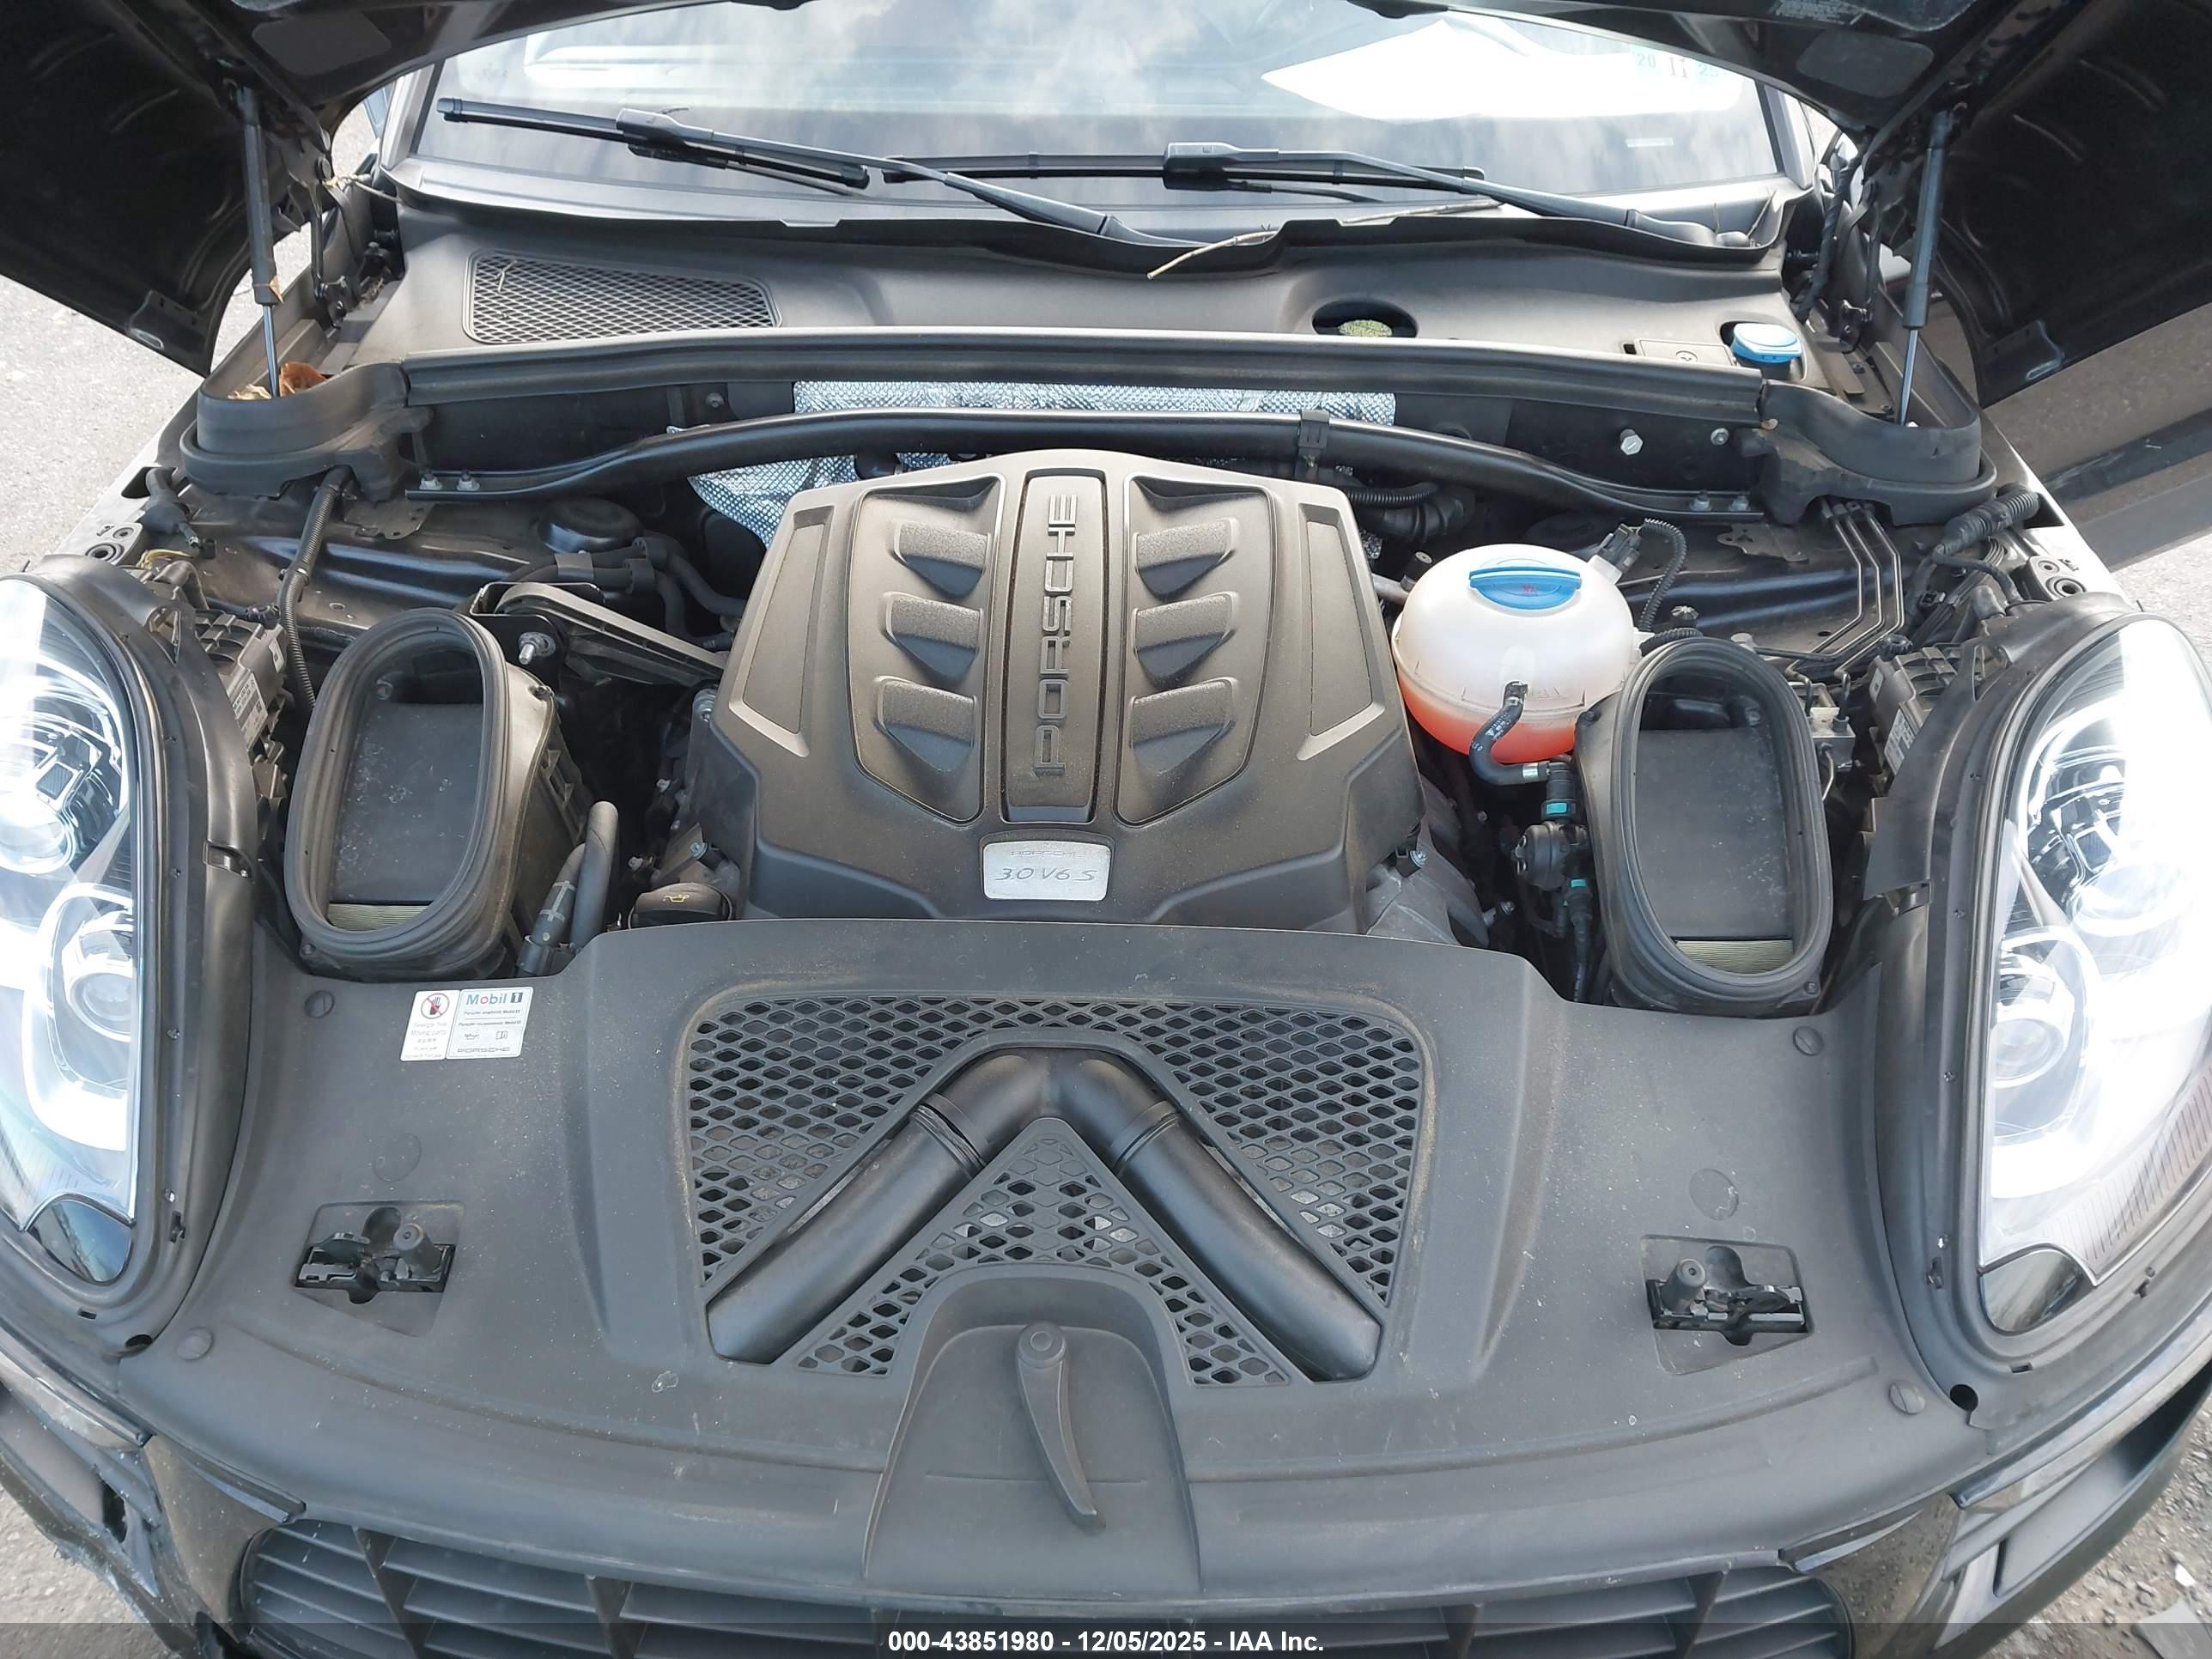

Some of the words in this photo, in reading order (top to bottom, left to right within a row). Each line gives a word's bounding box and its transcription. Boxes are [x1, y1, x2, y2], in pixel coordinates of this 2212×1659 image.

[1033, 494, 1078, 776] PORSCHE
[995, 867, 1035, 881] 3.0
[1042, 867, 1071, 882] V6
[1073, 870, 1098, 882] S
[465, 993, 507, 1006] Mobil
